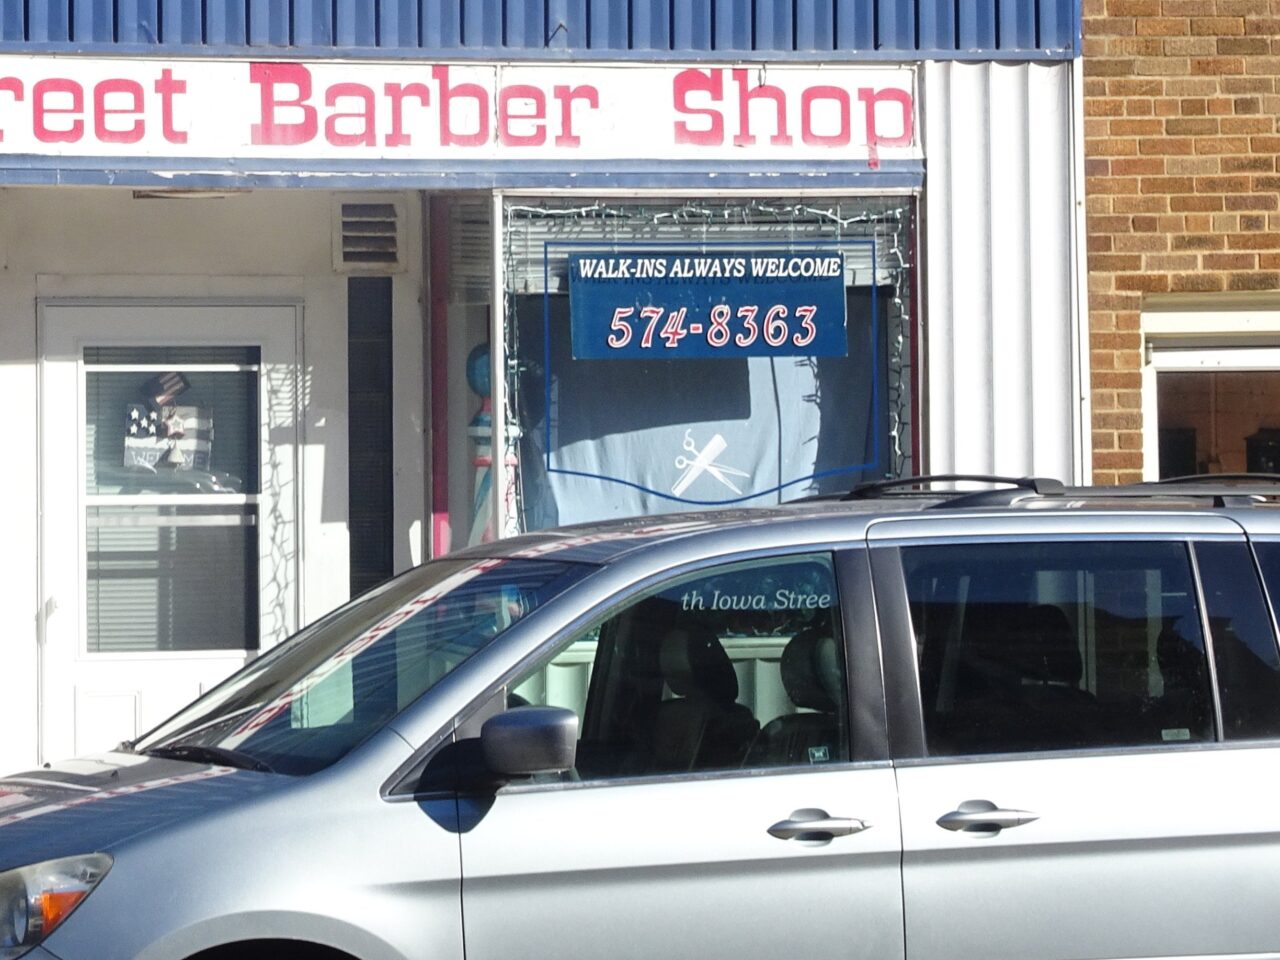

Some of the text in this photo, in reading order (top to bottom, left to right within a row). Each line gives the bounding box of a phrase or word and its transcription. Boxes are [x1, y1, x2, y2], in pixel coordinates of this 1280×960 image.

[249, 62, 600, 148] Barber
[673, 68, 913, 169] Shop
[579, 257, 842, 278] WALK-INS ALWAYS WELCOME
[607, 304, 818, 349] 574-8363
[710, 590, 766, 611] Iowa
